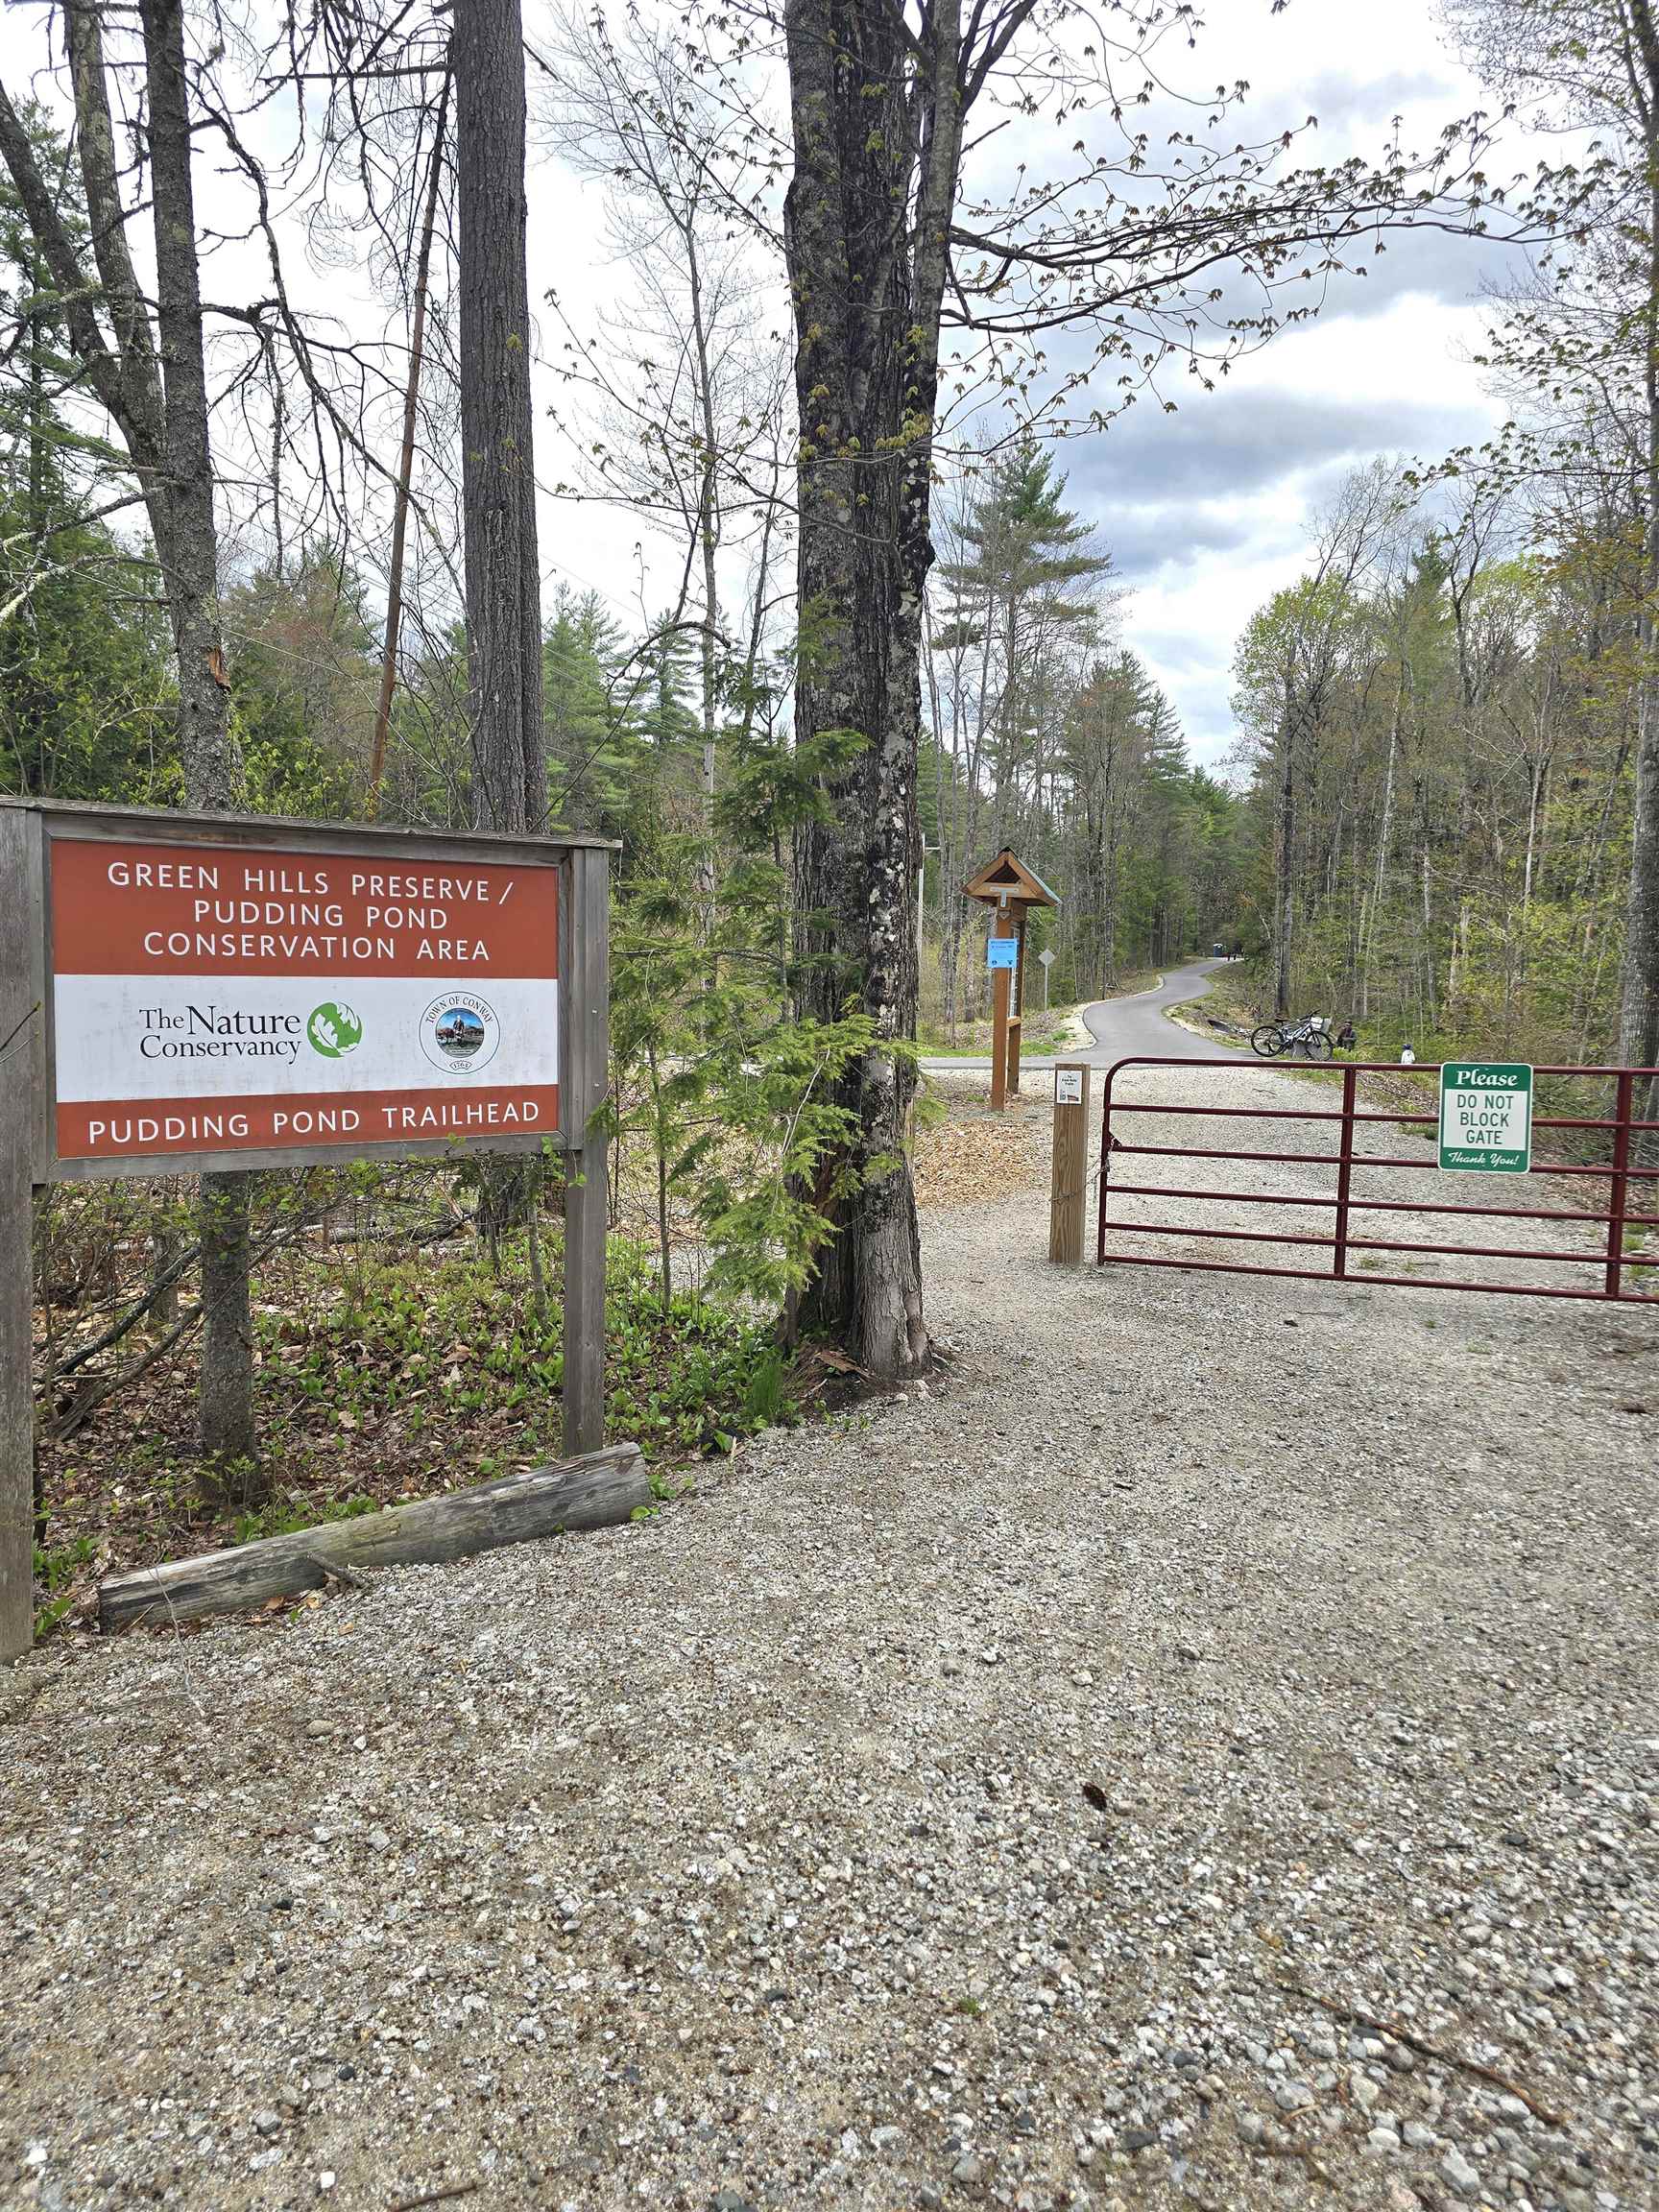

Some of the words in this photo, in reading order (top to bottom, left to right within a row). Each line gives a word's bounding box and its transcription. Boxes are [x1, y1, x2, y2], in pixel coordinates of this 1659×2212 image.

[108, 862, 218, 890] GREEN
[244, 869, 328, 895] HILLS
[351, 875, 490, 902] PRESERVE
[194, 900, 343, 926] PUDDING
[367, 905, 447, 929] POND
[144, 931, 395, 959] CONSERVATION
[416, 938, 490, 961] AREA
[139, 1008, 185, 1030] The
[185, 1005, 301, 1036] Nature
[425, 1000, 447, 1023] TOWN
[448, 997, 461, 1005] OF
[462, 997, 494, 1023] CONWAY
[139, 1036, 301, 1065] Conservancy
[1455, 1069, 1519, 1087] Please
[1456, 1094, 1478, 1109] DO
[1484, 1094, 1514, 1110] NOT
[89, 1114, 249, 1144] PUDDING
[274, 1109, 360, 1135] POND
[381, 1101, 539, 1129] TRAILHEAD
[1459, 1112, 1509, 1127] BLOCK
[1466, 1130, 1503, 1145] GATE
[1448, 1152, 1486, 1165] Thank
[1489, 1153, 1520, 1166] You!
